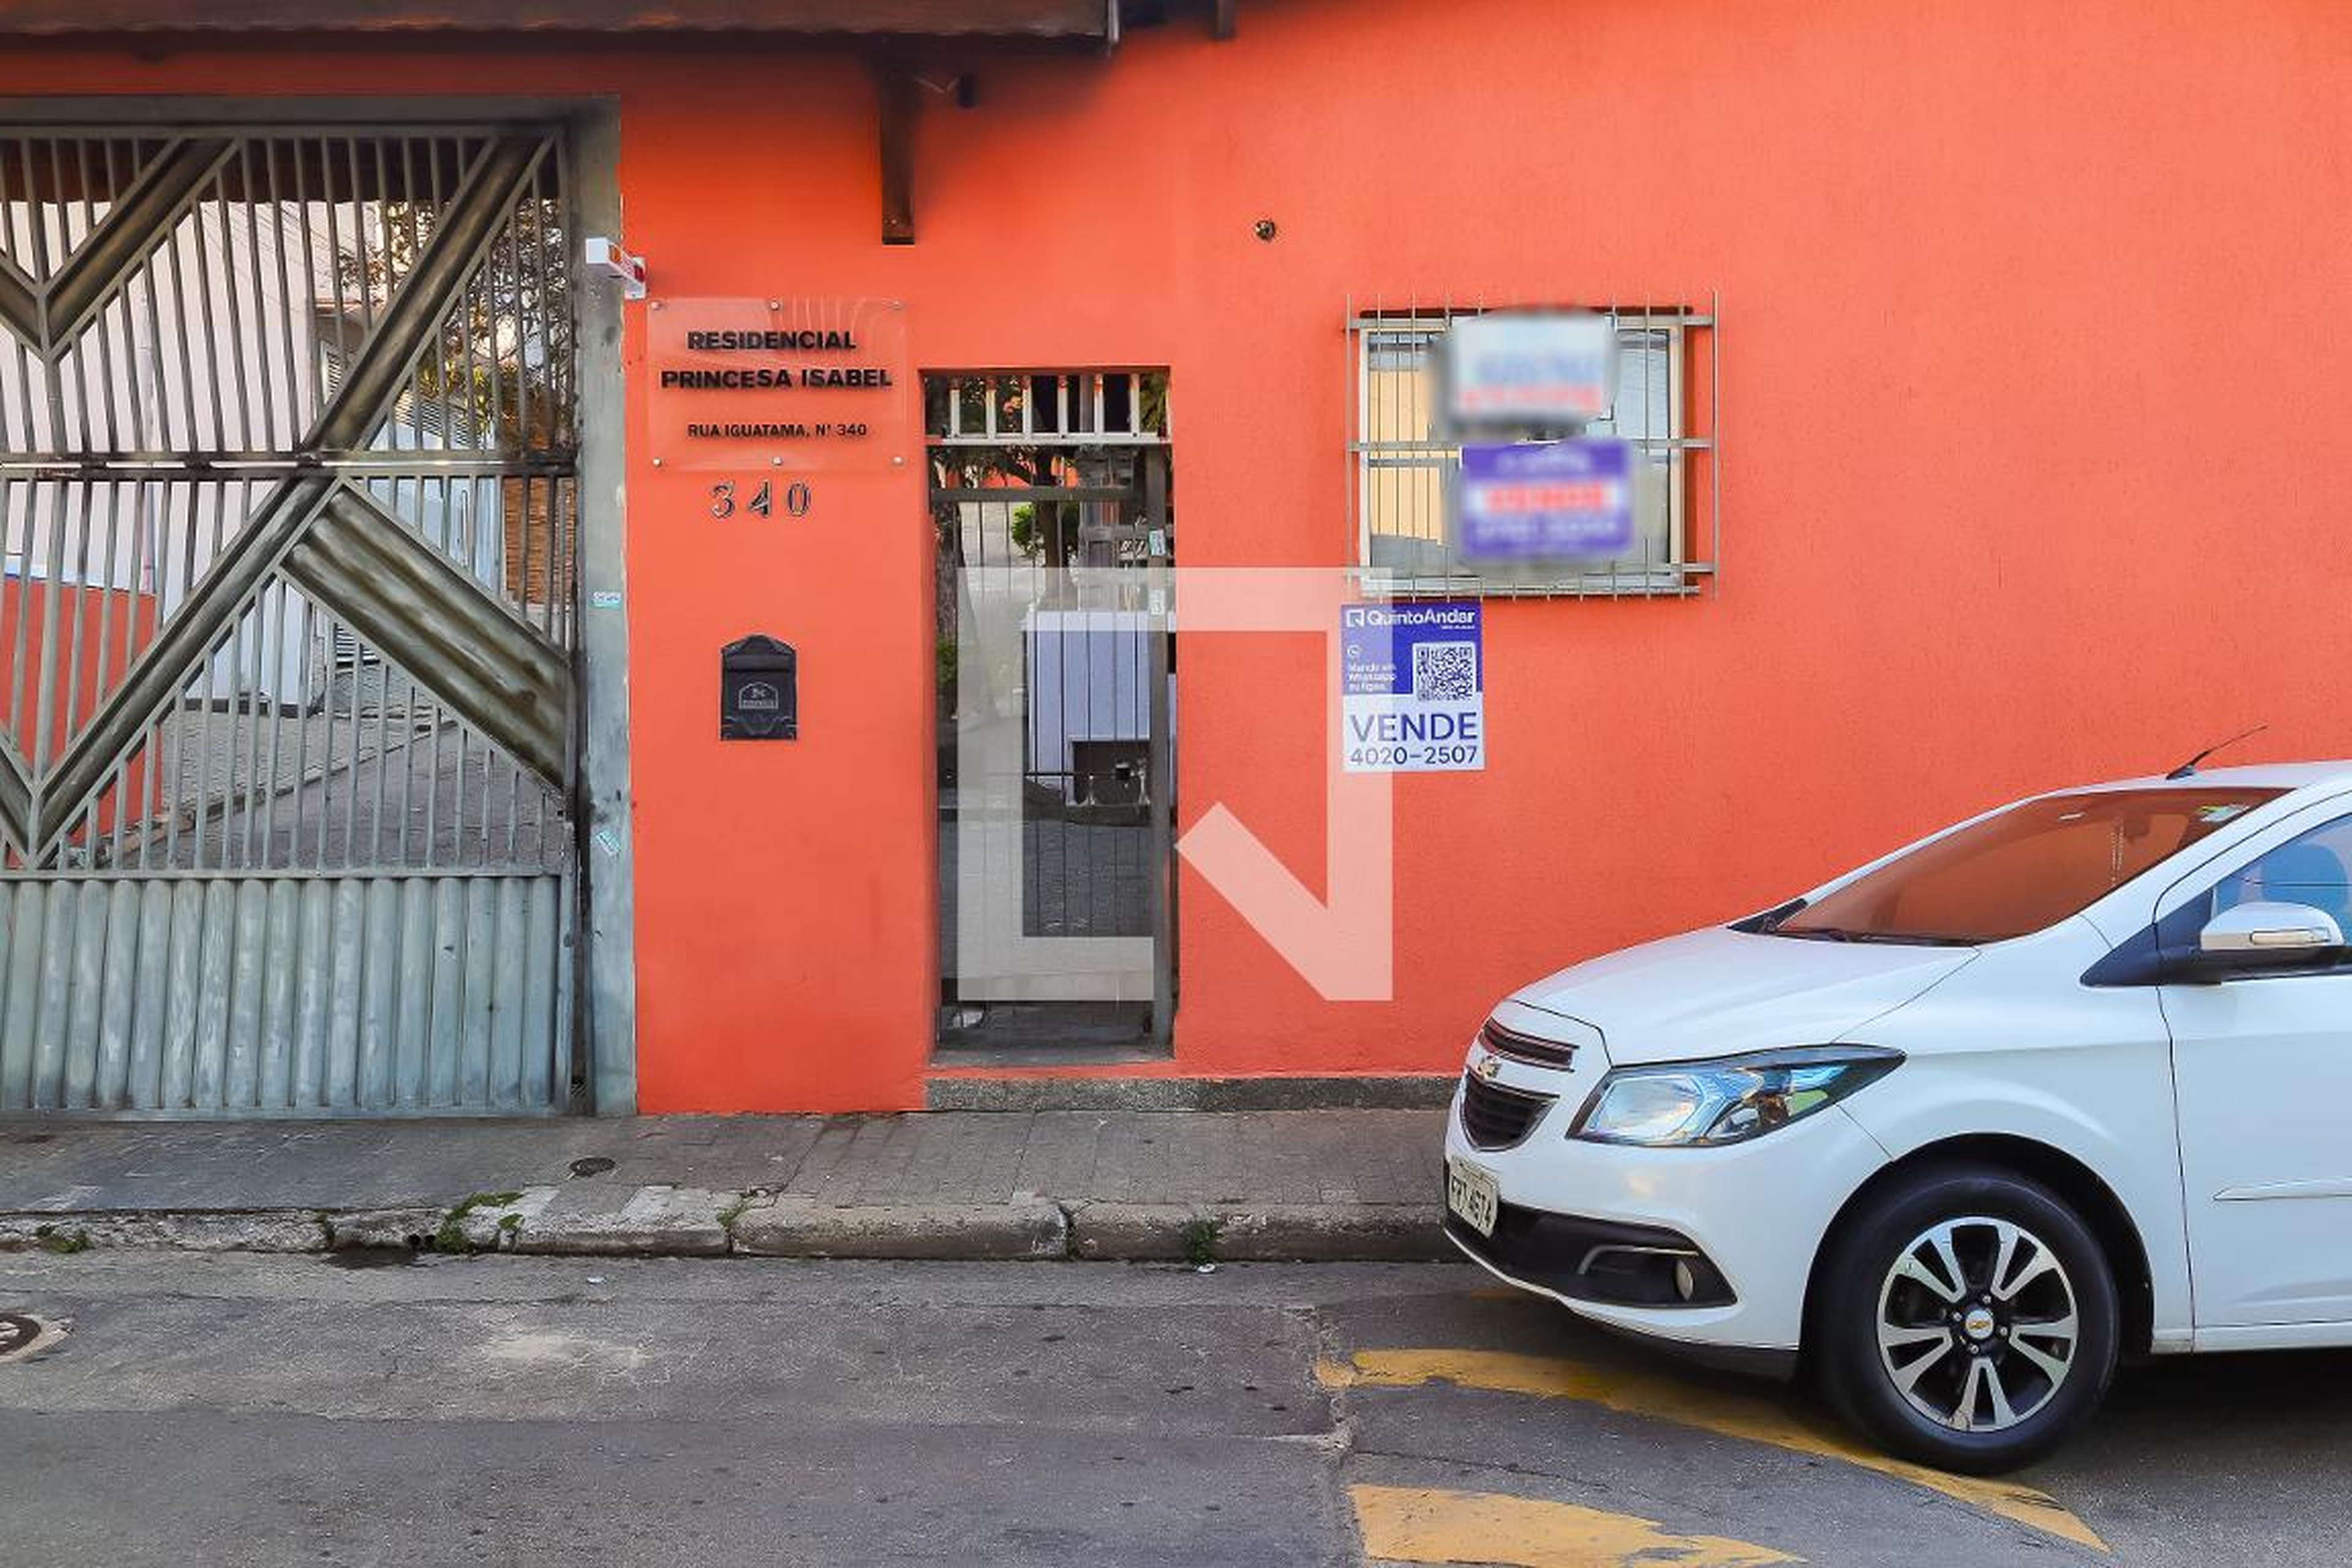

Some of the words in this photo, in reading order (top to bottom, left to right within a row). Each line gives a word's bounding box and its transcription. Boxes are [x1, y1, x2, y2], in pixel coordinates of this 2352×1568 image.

[687, 331, 857, 350] RESIDENCIAL
[661, 369, 793, 388] PRINCESA
[802, 369, 892, 387] ISABEL
[687, 424, 720, 437] RUA
[725, 424, 810, 438] IGUATAMA,
[837, 423, 867, 435] 340
[710, 480, 812, 519] 340
[1366, 608, 1476, 625] QuintoAndar
[1350, 712, 1477, 742] VENDE
[1351, 745, 1477, 765] 4020-2507
